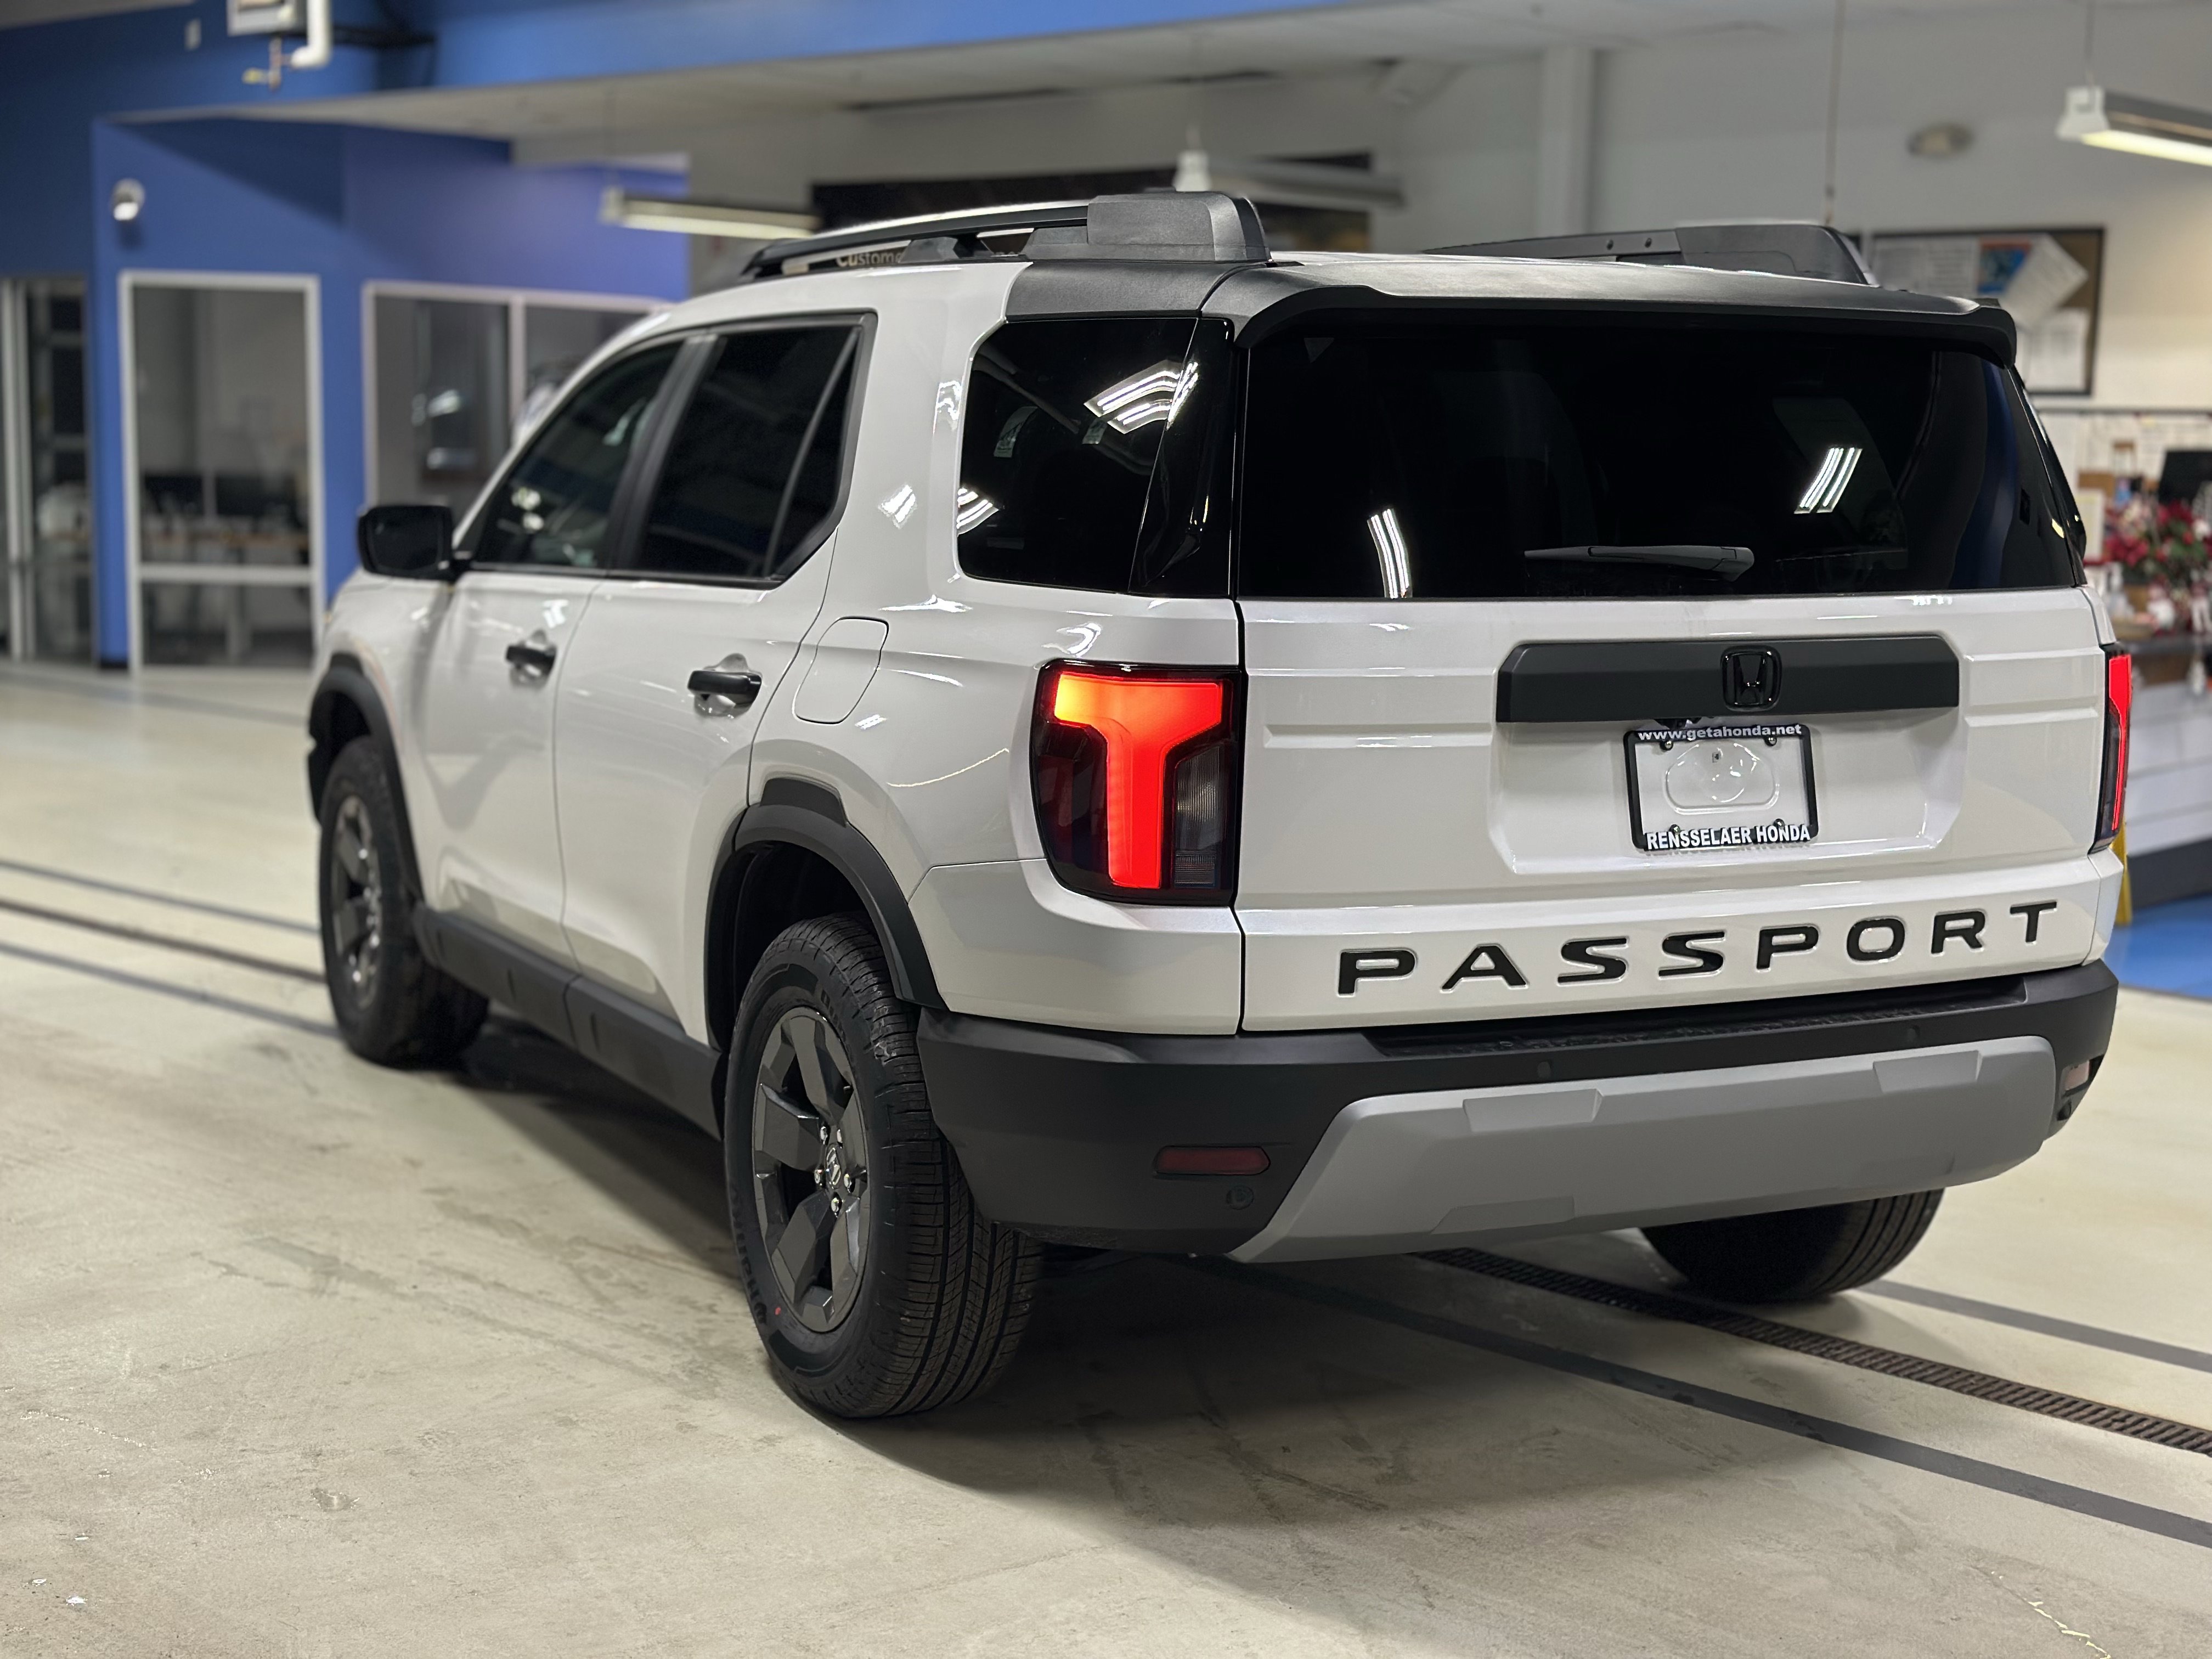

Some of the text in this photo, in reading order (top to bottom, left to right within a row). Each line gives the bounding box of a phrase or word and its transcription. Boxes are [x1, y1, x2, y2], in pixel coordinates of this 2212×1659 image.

[1638, 725, 1802, 741] www.getahonda.net
[1647, 825, 1810, 850] RENSSELAER HONDA
[1338, 901, 2057, 996] PASSPORT
